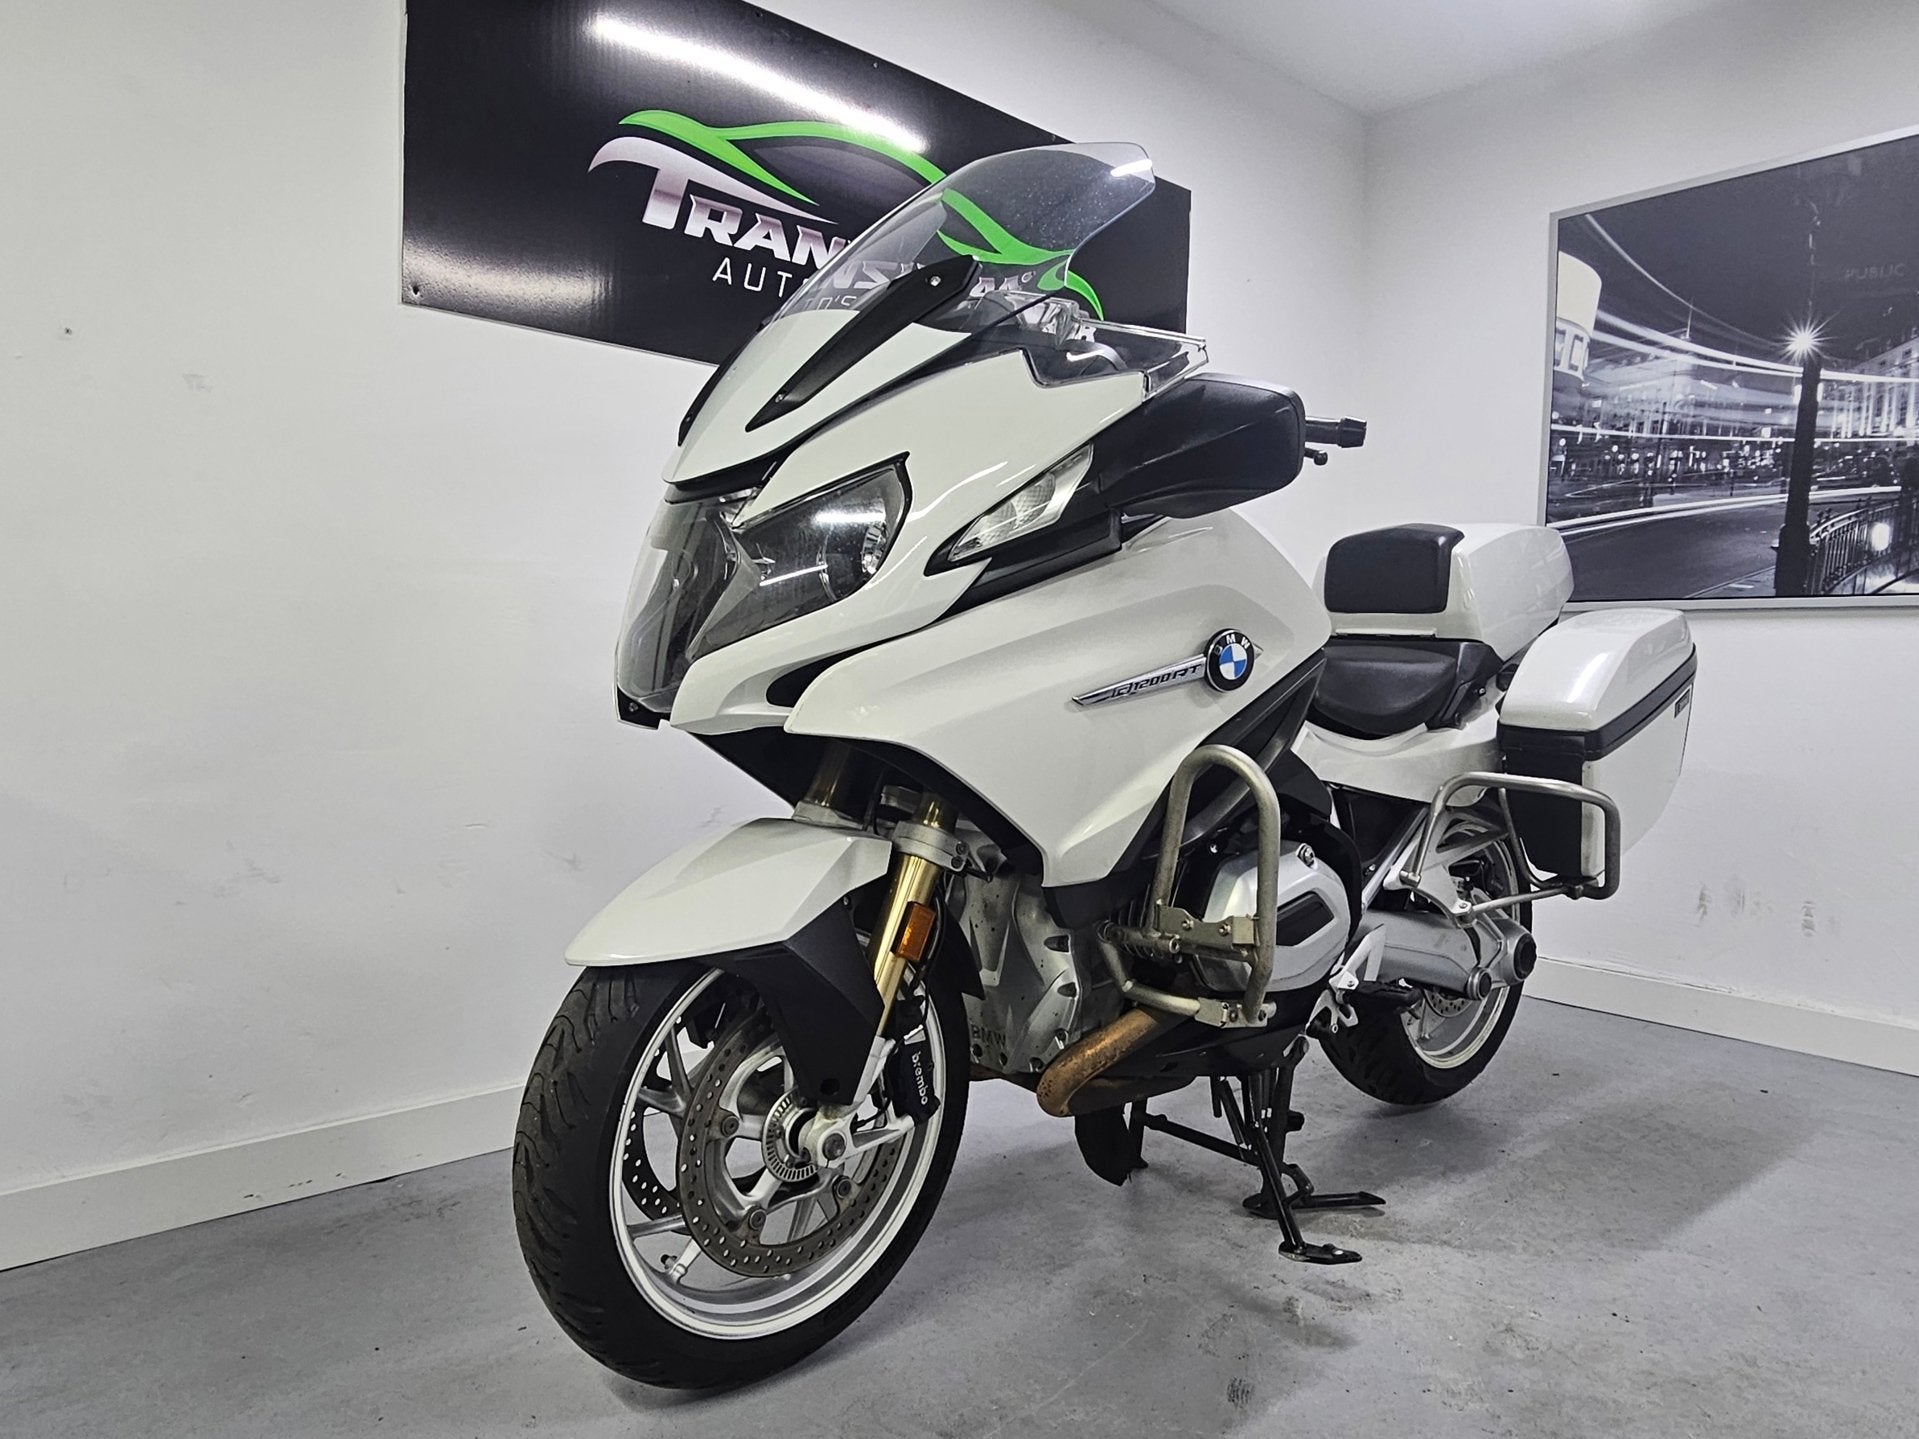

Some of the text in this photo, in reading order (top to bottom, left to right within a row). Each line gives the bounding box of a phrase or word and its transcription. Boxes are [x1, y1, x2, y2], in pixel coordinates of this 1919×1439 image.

[1214, 634, 1250, 655] BMW
[971, 1024, 1007, 1047] BMW
[911, 1051, 928, 1105] brembo
